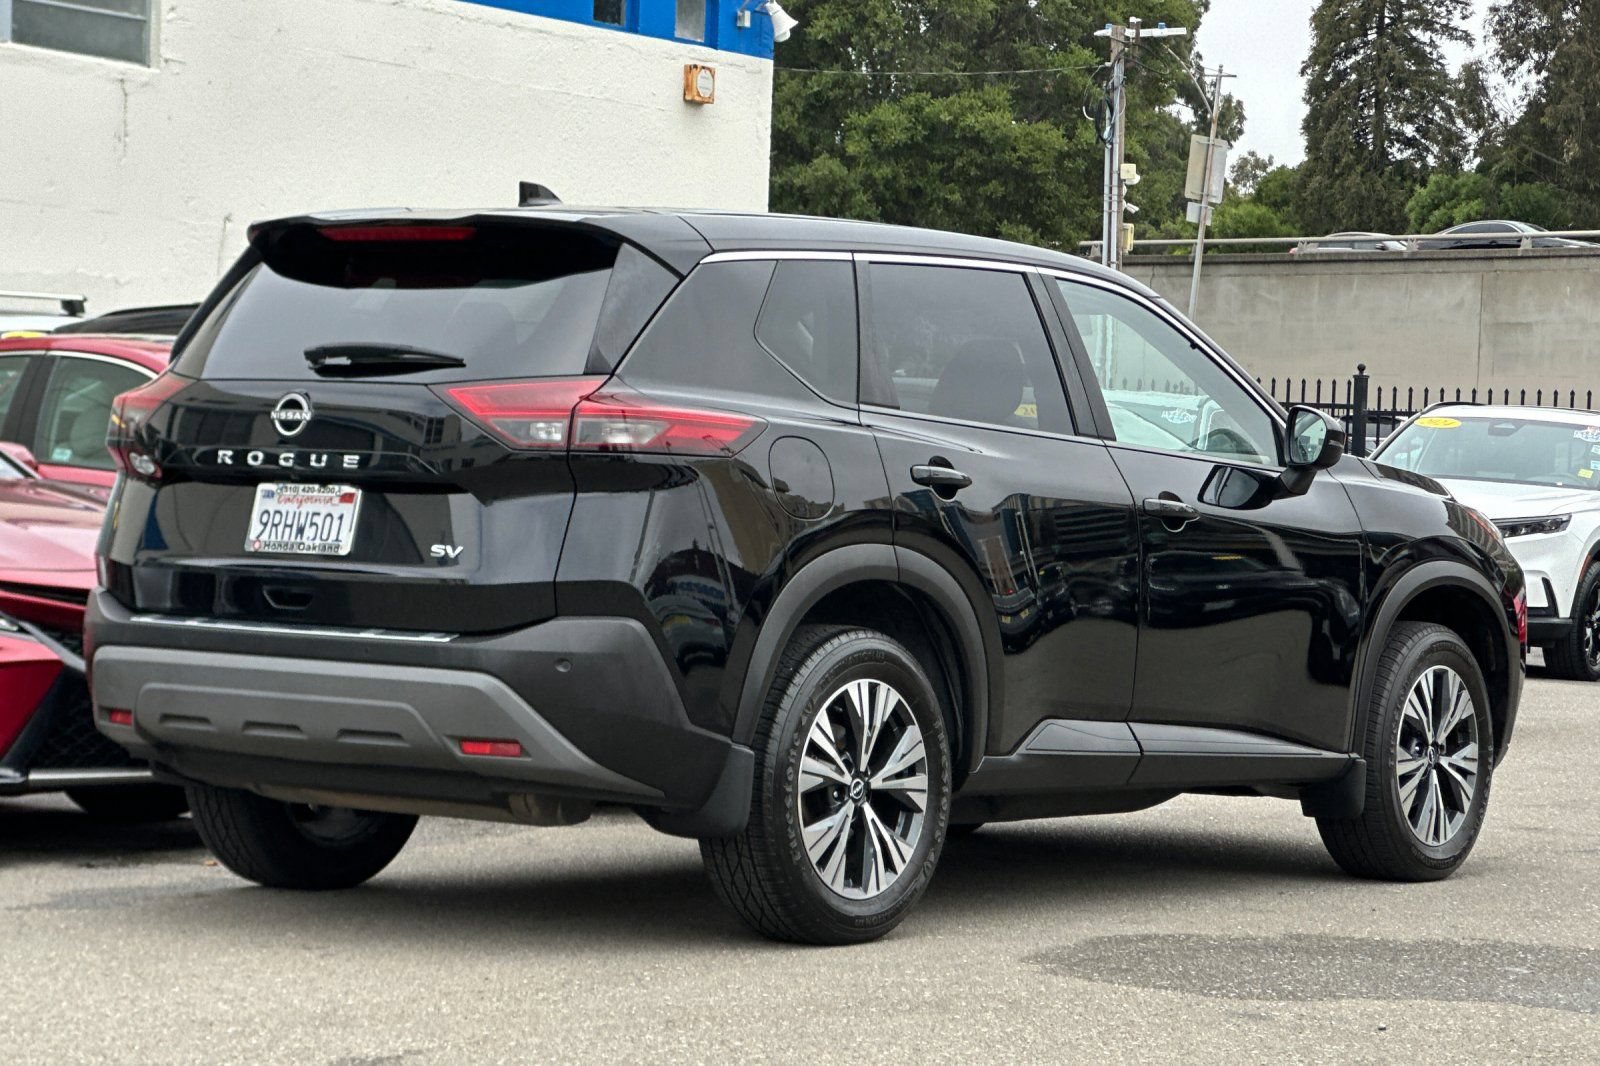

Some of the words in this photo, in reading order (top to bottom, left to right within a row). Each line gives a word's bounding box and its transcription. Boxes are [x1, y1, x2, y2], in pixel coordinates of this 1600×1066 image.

[271, 411, 311, 420] NISSAN
[217, 449, 361, 469] ROGUE
[277, 494, 335, 509] California
[255, 509, 345, 543] 9RHW501
[263, 540, 294, 551] Honda
[298, 541, 341, 553] Oakland
[430, 544, 464, 559] SV
